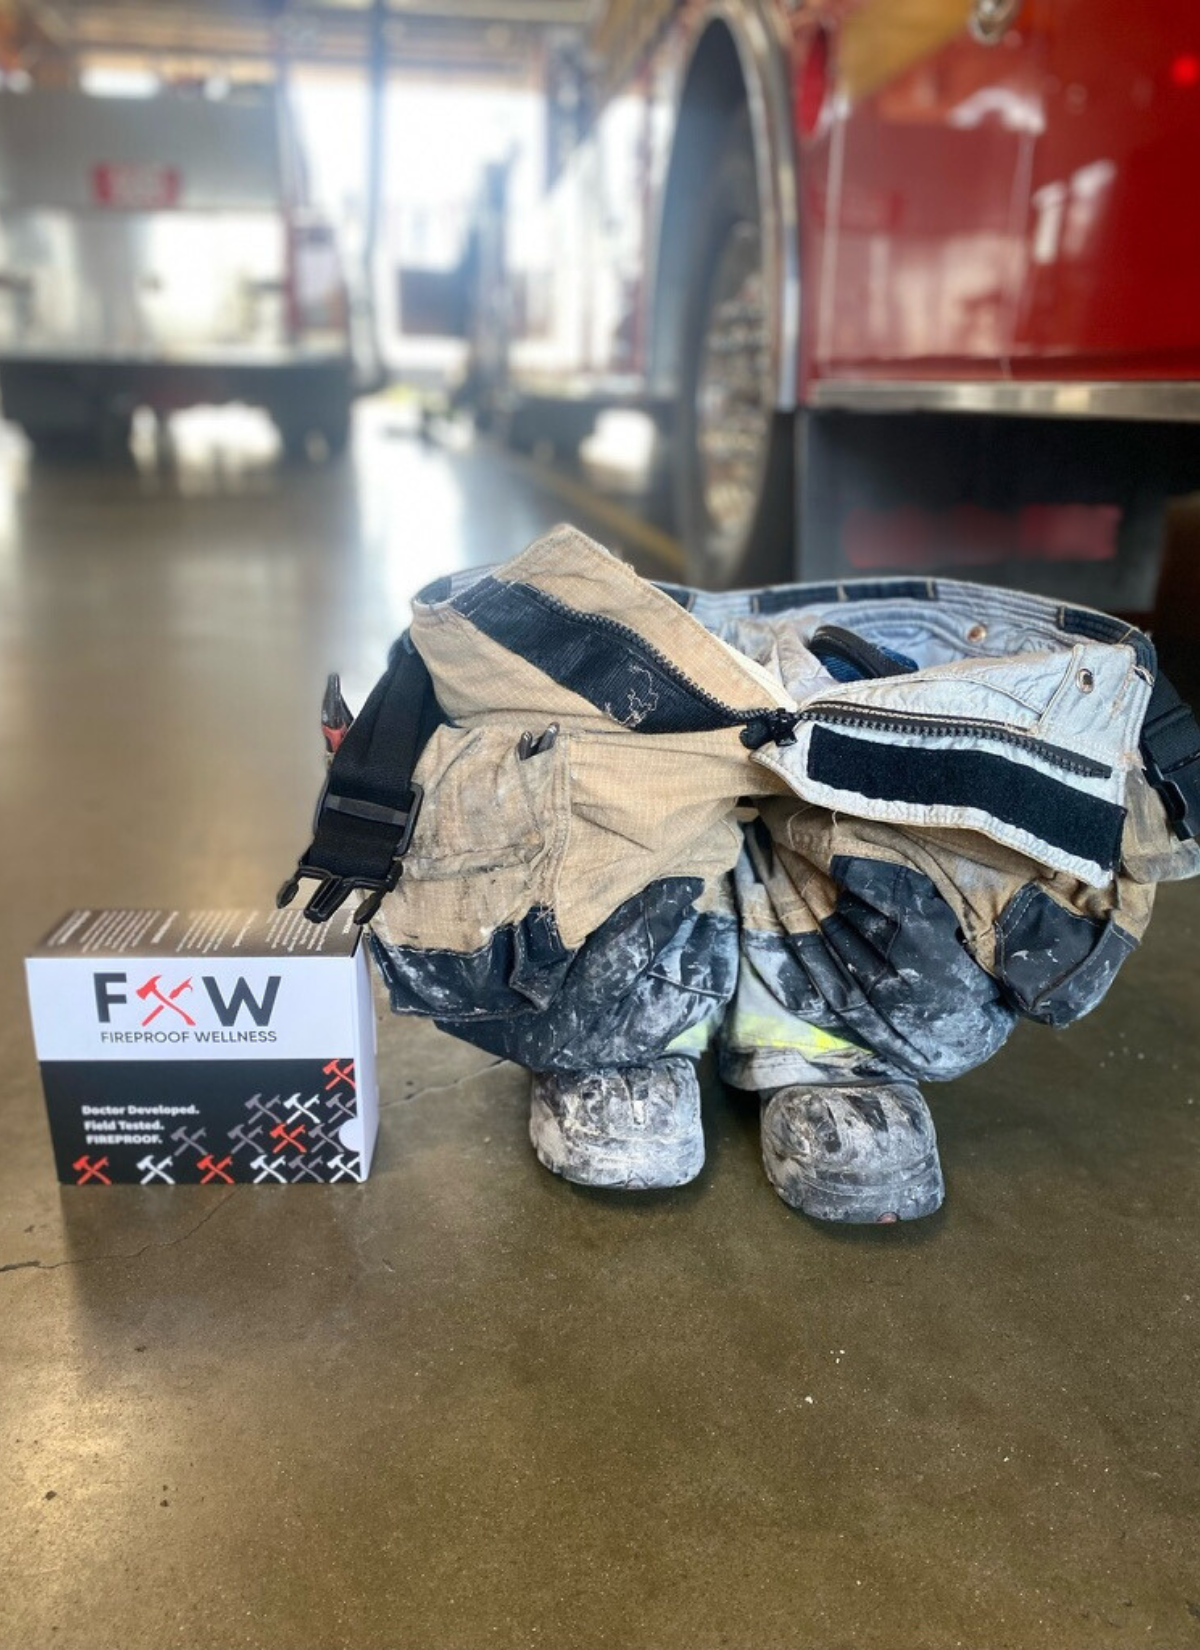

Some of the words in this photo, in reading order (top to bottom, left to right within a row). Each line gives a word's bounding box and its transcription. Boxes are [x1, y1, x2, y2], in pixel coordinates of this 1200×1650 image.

[101, 1031, 190, 1043] FIREPROOF
[194, 1031, 278, 1043] WELLNESS
[81, 1105, 125, 1116] Doctor
[127, 1104, 200, 1117] Developed.
[84, 1120, 117, 1131] Field
[118, 1120, 165, 1131] Tested.
[86, 1134, 163, 1145] FIREPROOF.
